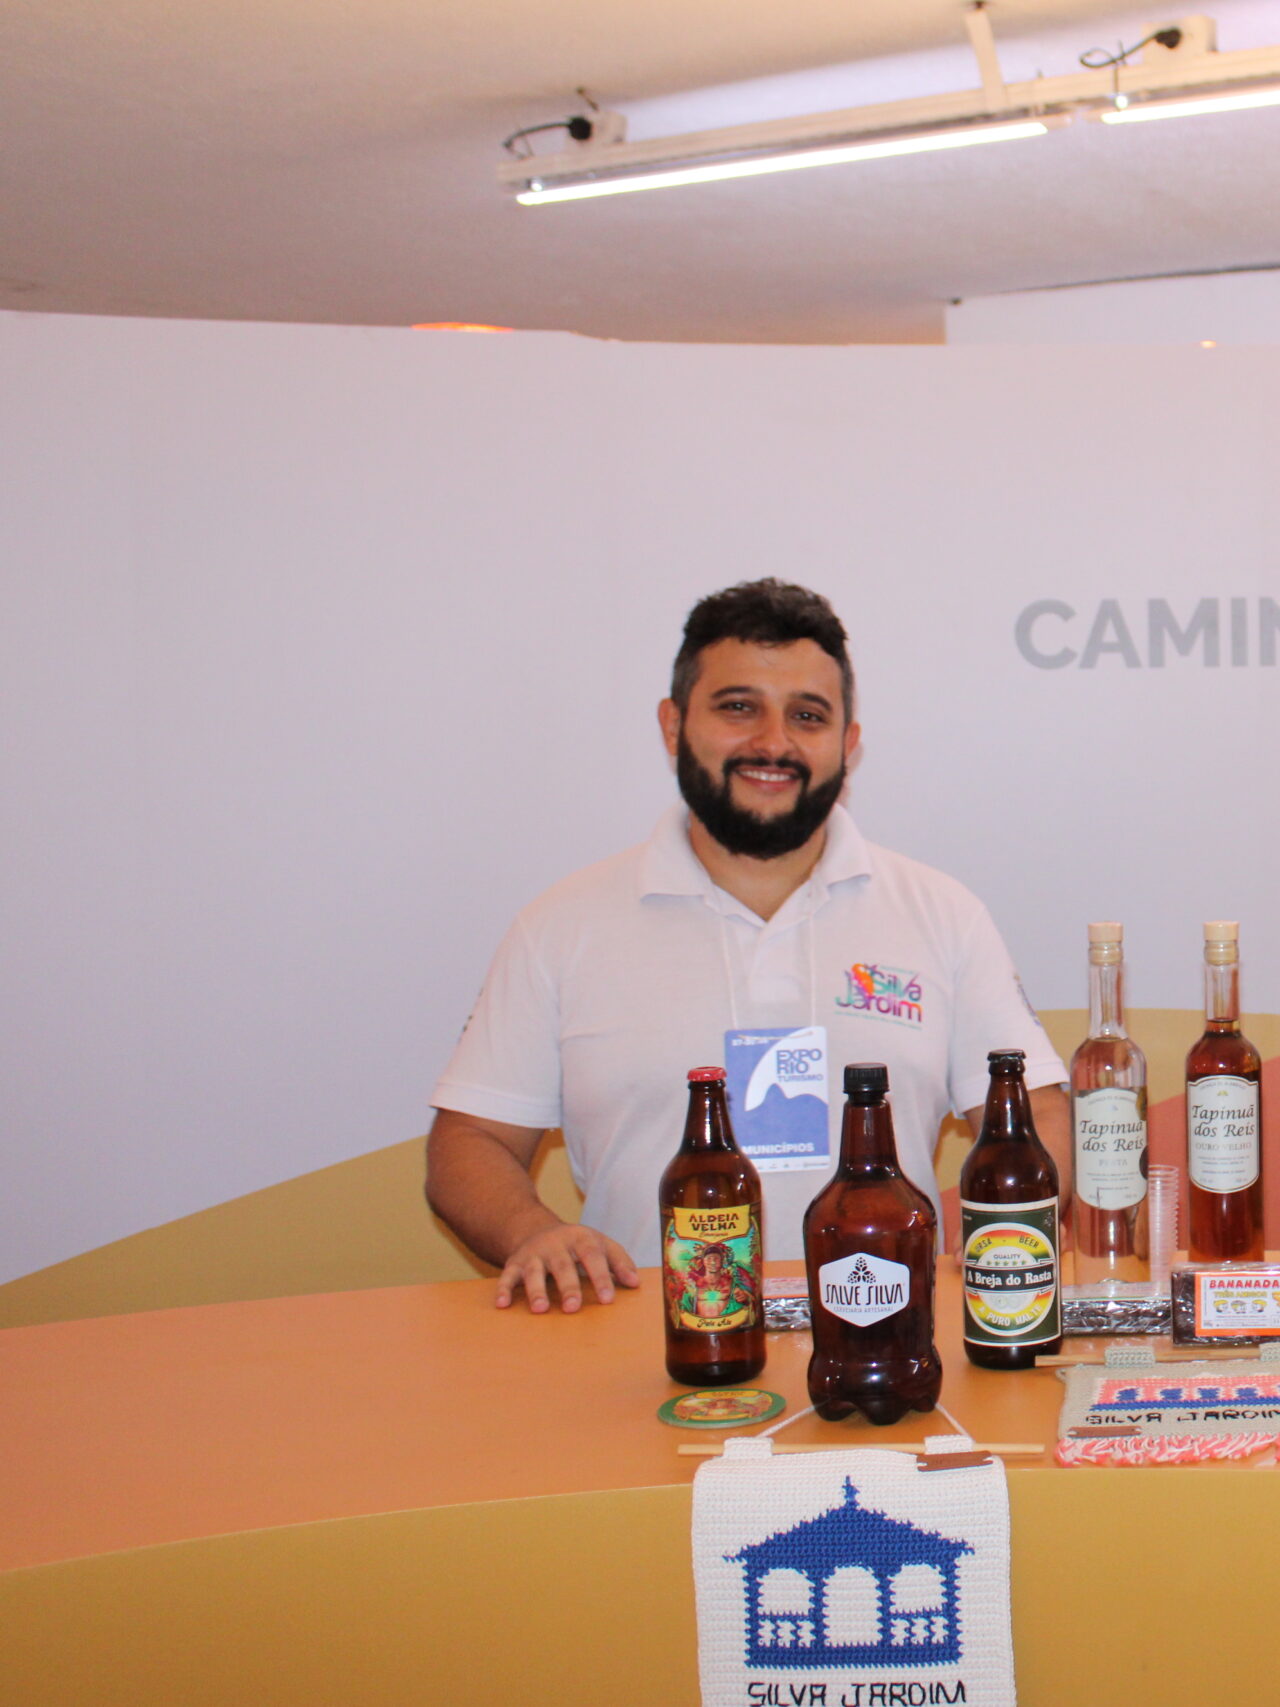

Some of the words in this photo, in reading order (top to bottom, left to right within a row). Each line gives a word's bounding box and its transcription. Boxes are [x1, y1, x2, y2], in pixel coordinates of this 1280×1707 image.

[776, 1048, 823, 1061] EXPO
[776, 1060, 809, 1075] RIO
[777, 1074, 824, 1082] TURISMO
[1191, 1104, 1255, 1125] Tapinuã
[1194, 1121, 1218, 1138] dos
[1223, 1122, 1256, 1138] Reis
[1081, 1136, 1108, 1152] dos
[1113, 1136, 1144, 1152] Reis
[688, 1212, 739, 1224] ALDEIA
[691, 1222, 737, 1232] VELHA
[1018, 1235, 1040, 1249] BEER
[967, 1270, 974, 1283] A
[975, 1271, 1003, 1288] Breja
[1005, 1273, 1022, 1286] do
[1024, 1270, 1053, 1285] Rasta
[1208, 1279, 1280, 1289] BANANADA
[825, 1283, 862, 1306] SALVE
[865, 1283, 904, 1306] SILVA
[986, 1312, 1011, 1327] PURO
[1085, 1412, 1162, 1425] SILVA
[746, 1681, 828, 1707] SILVA
[839, 1679, 967, 1707] JARDIM
